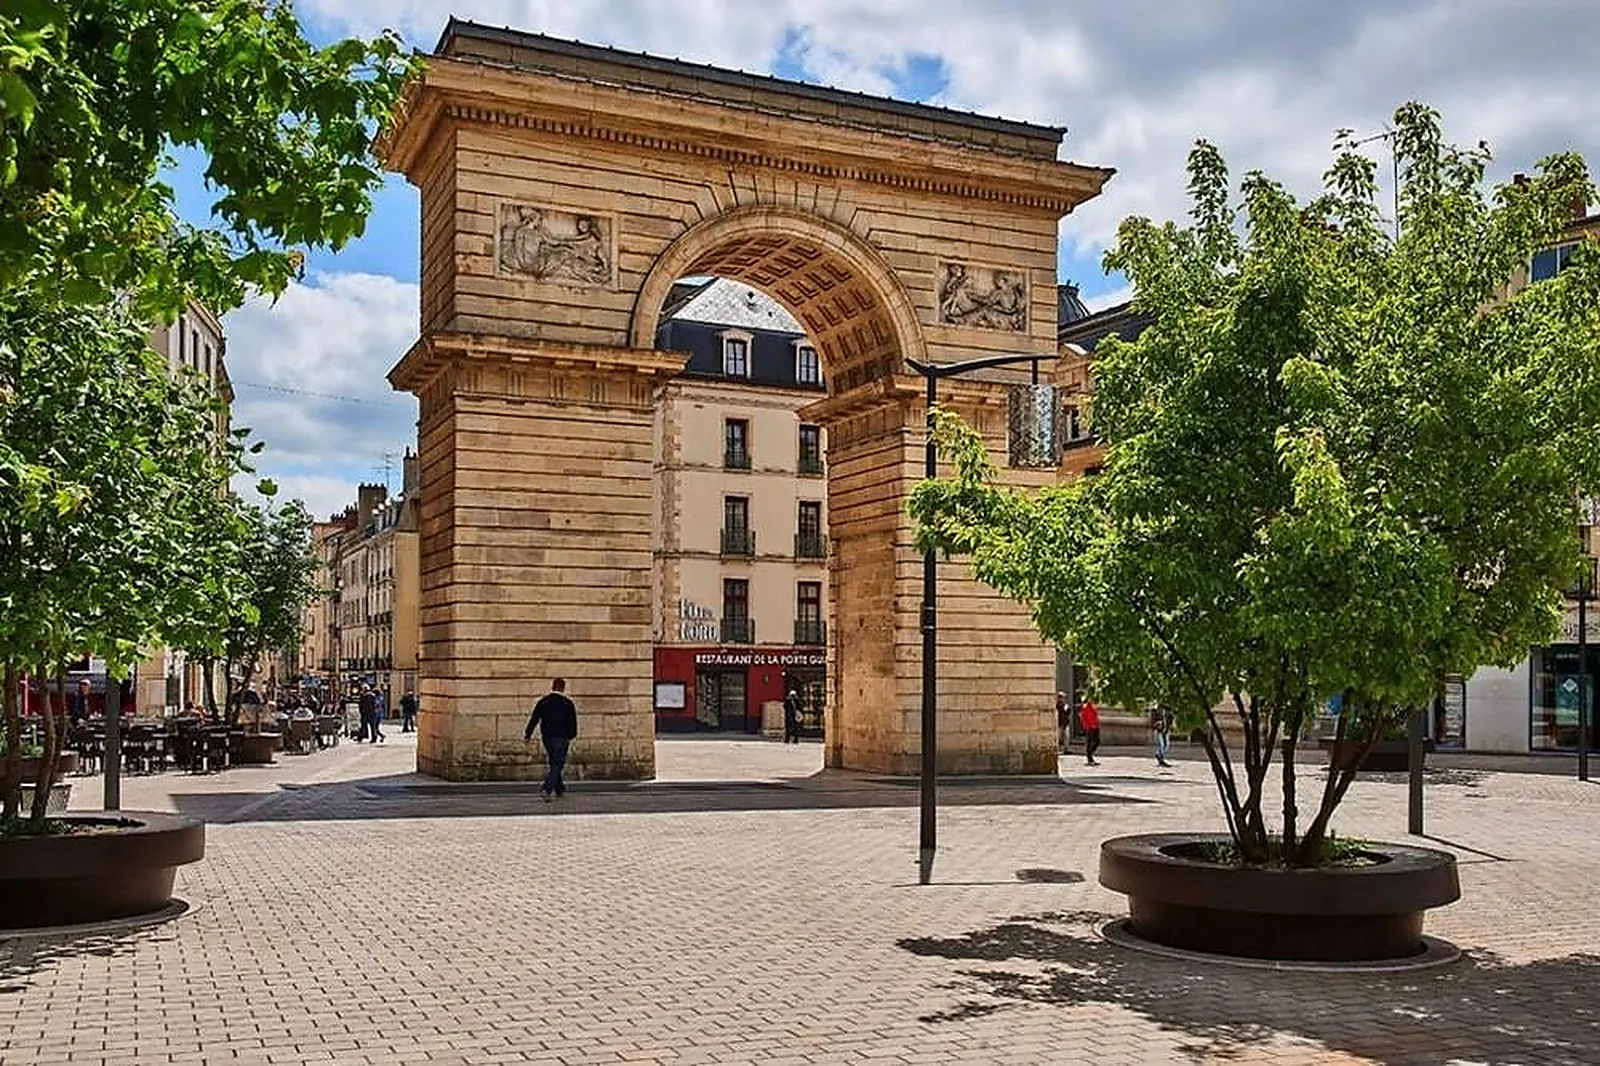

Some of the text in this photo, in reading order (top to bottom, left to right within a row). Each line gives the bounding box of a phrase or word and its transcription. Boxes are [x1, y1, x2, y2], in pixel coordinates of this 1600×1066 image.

[695, 654, 752, 665] RESTAURANT
[754, 654, 766, 665] DE
[767, 655, 780, 665] LA
[780, 655, 808, 665] PORTE
